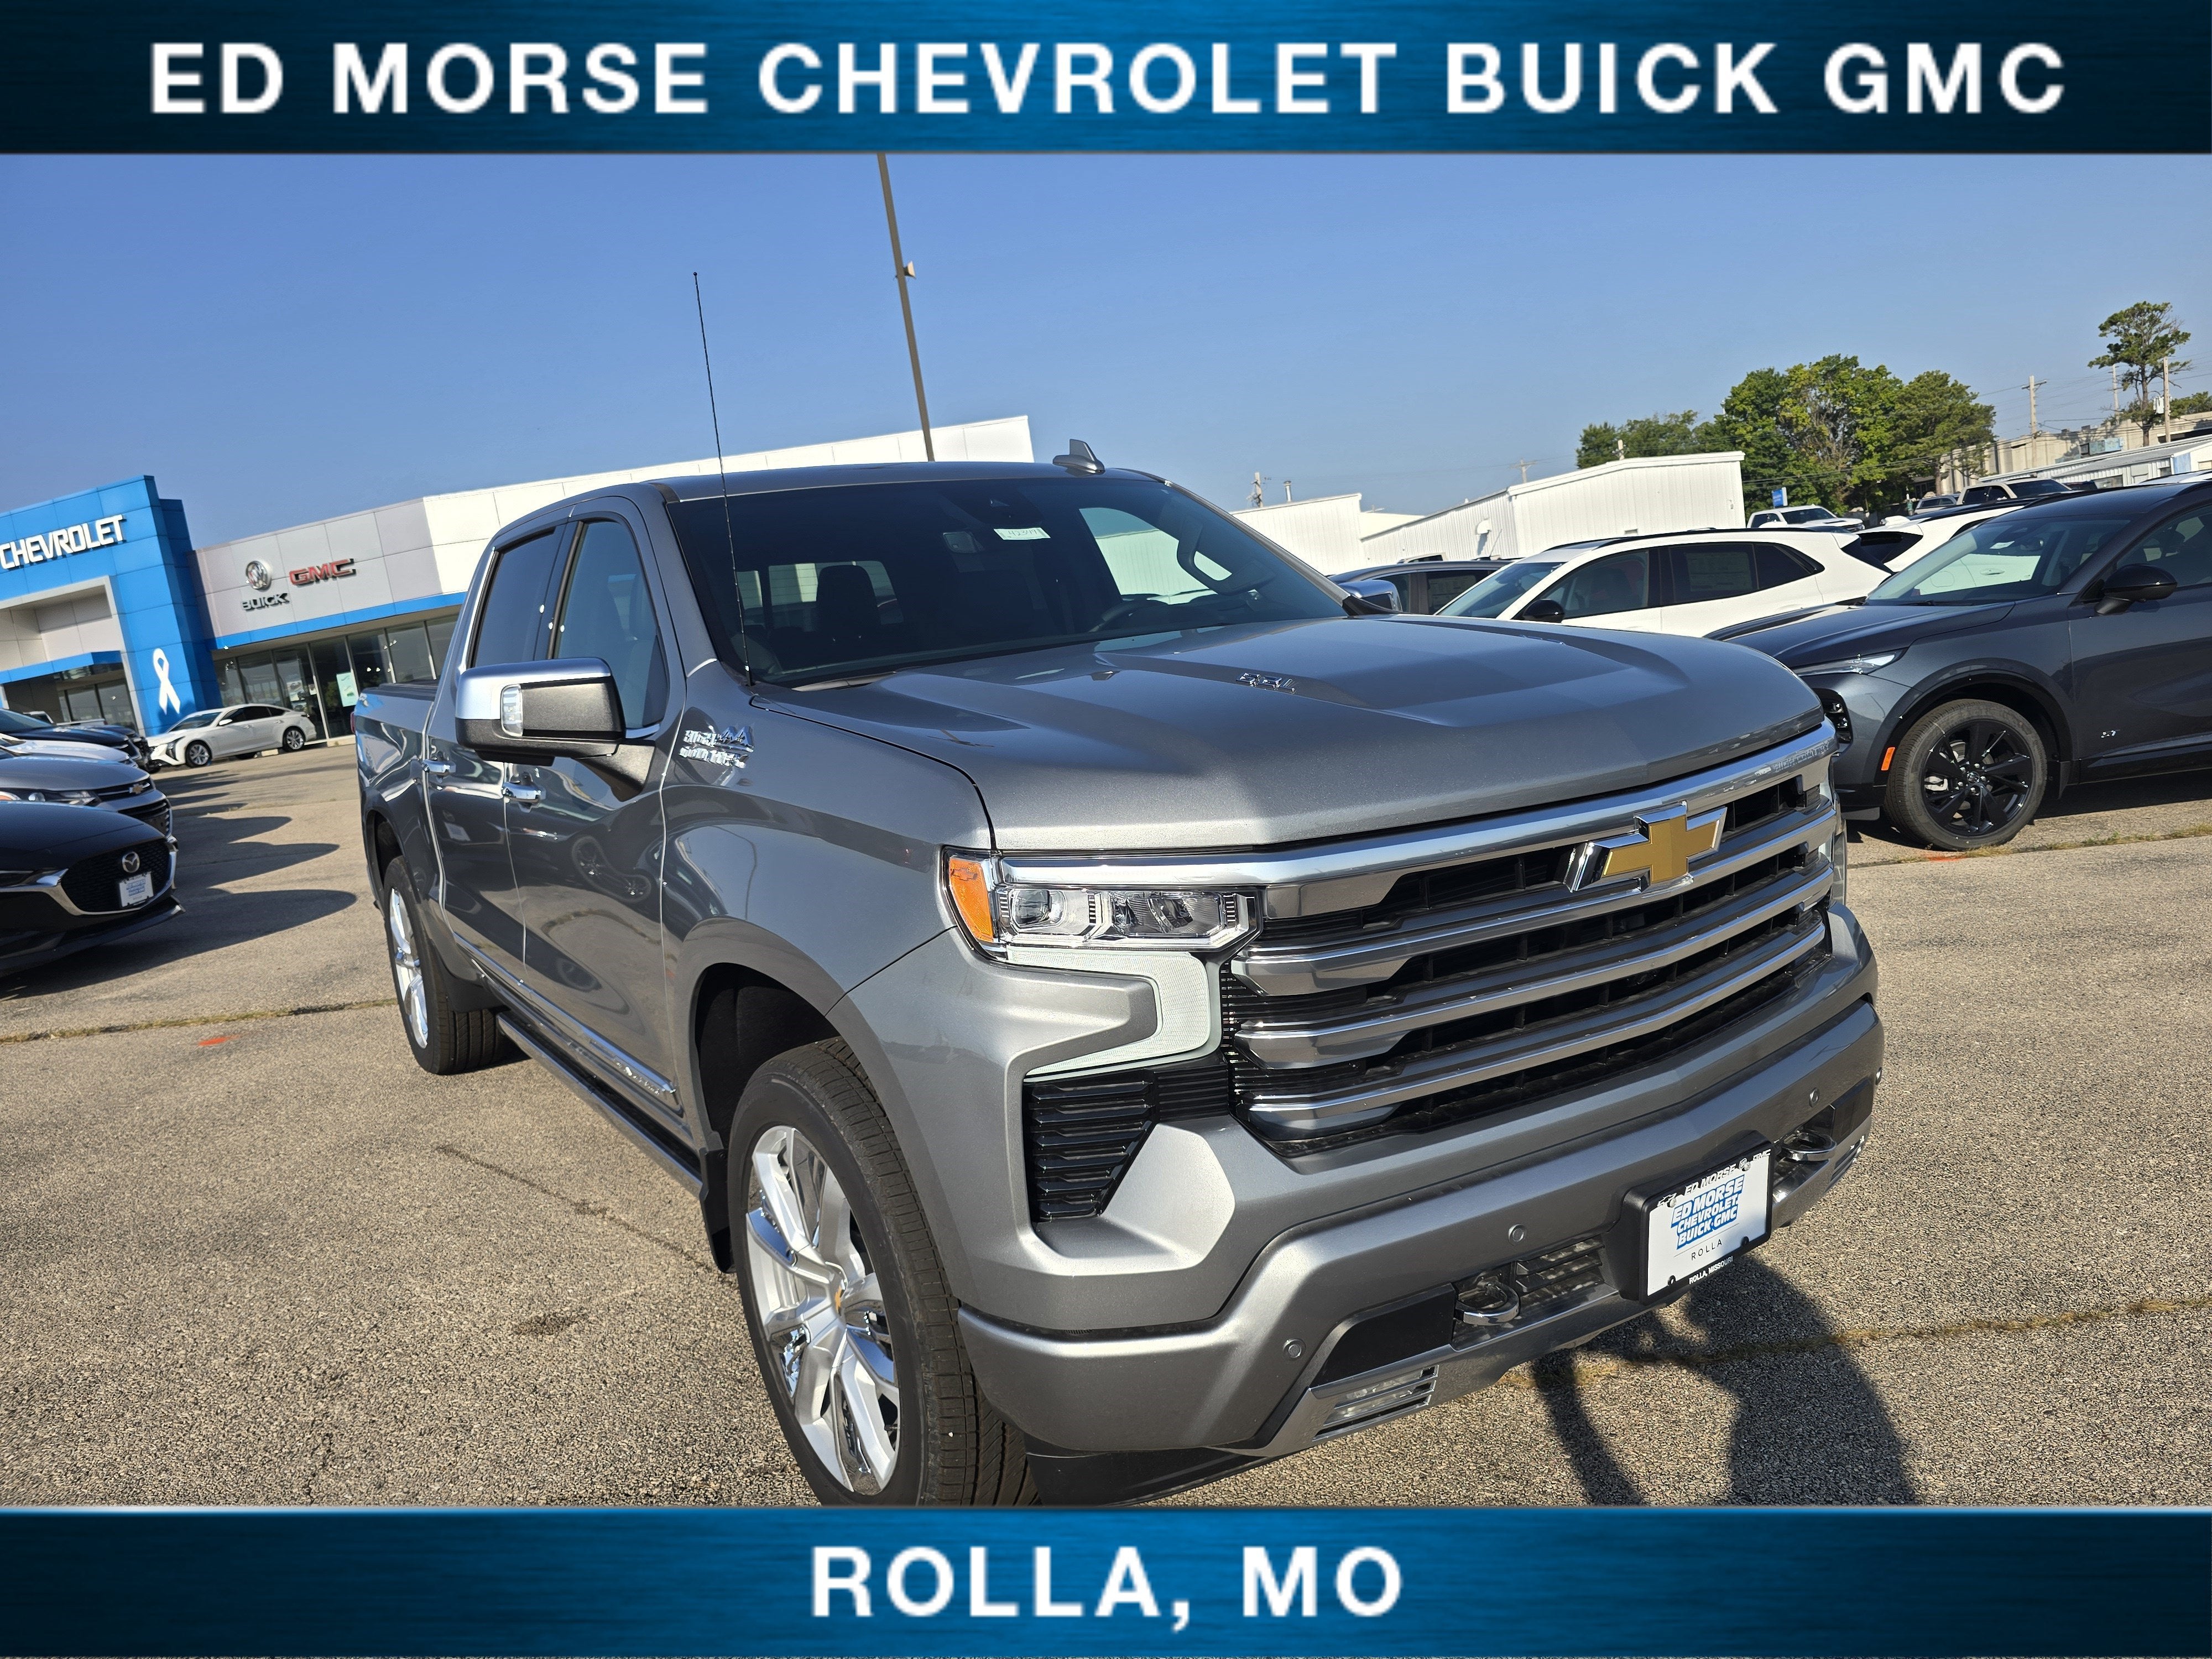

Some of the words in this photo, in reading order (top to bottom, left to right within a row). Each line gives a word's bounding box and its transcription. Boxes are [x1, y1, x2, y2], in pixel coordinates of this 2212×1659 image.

[0, 514, 123, 570] CHEVROLET
[289, 559, 355, 586] GMC
[242, 593, 289, 611] BUICK
[1684, 1181, 1699, 1196] ED
[1700, 1163, 1736, 1189] MORSE
[1752, 1149, 1771, 1161] GMC
[1671, 1201, 1693, 1225] ED
[1693, 1175, 1744, 1214] MORSE
[1678, 1193, 1738, 1233] CHEVROLET
[1691, 1239, 1722, 1261] ROLLA
[1688, 1270, 1708, 1285] ROLLA,
[1708, 1255, 1733, 1275] MISSOURI
